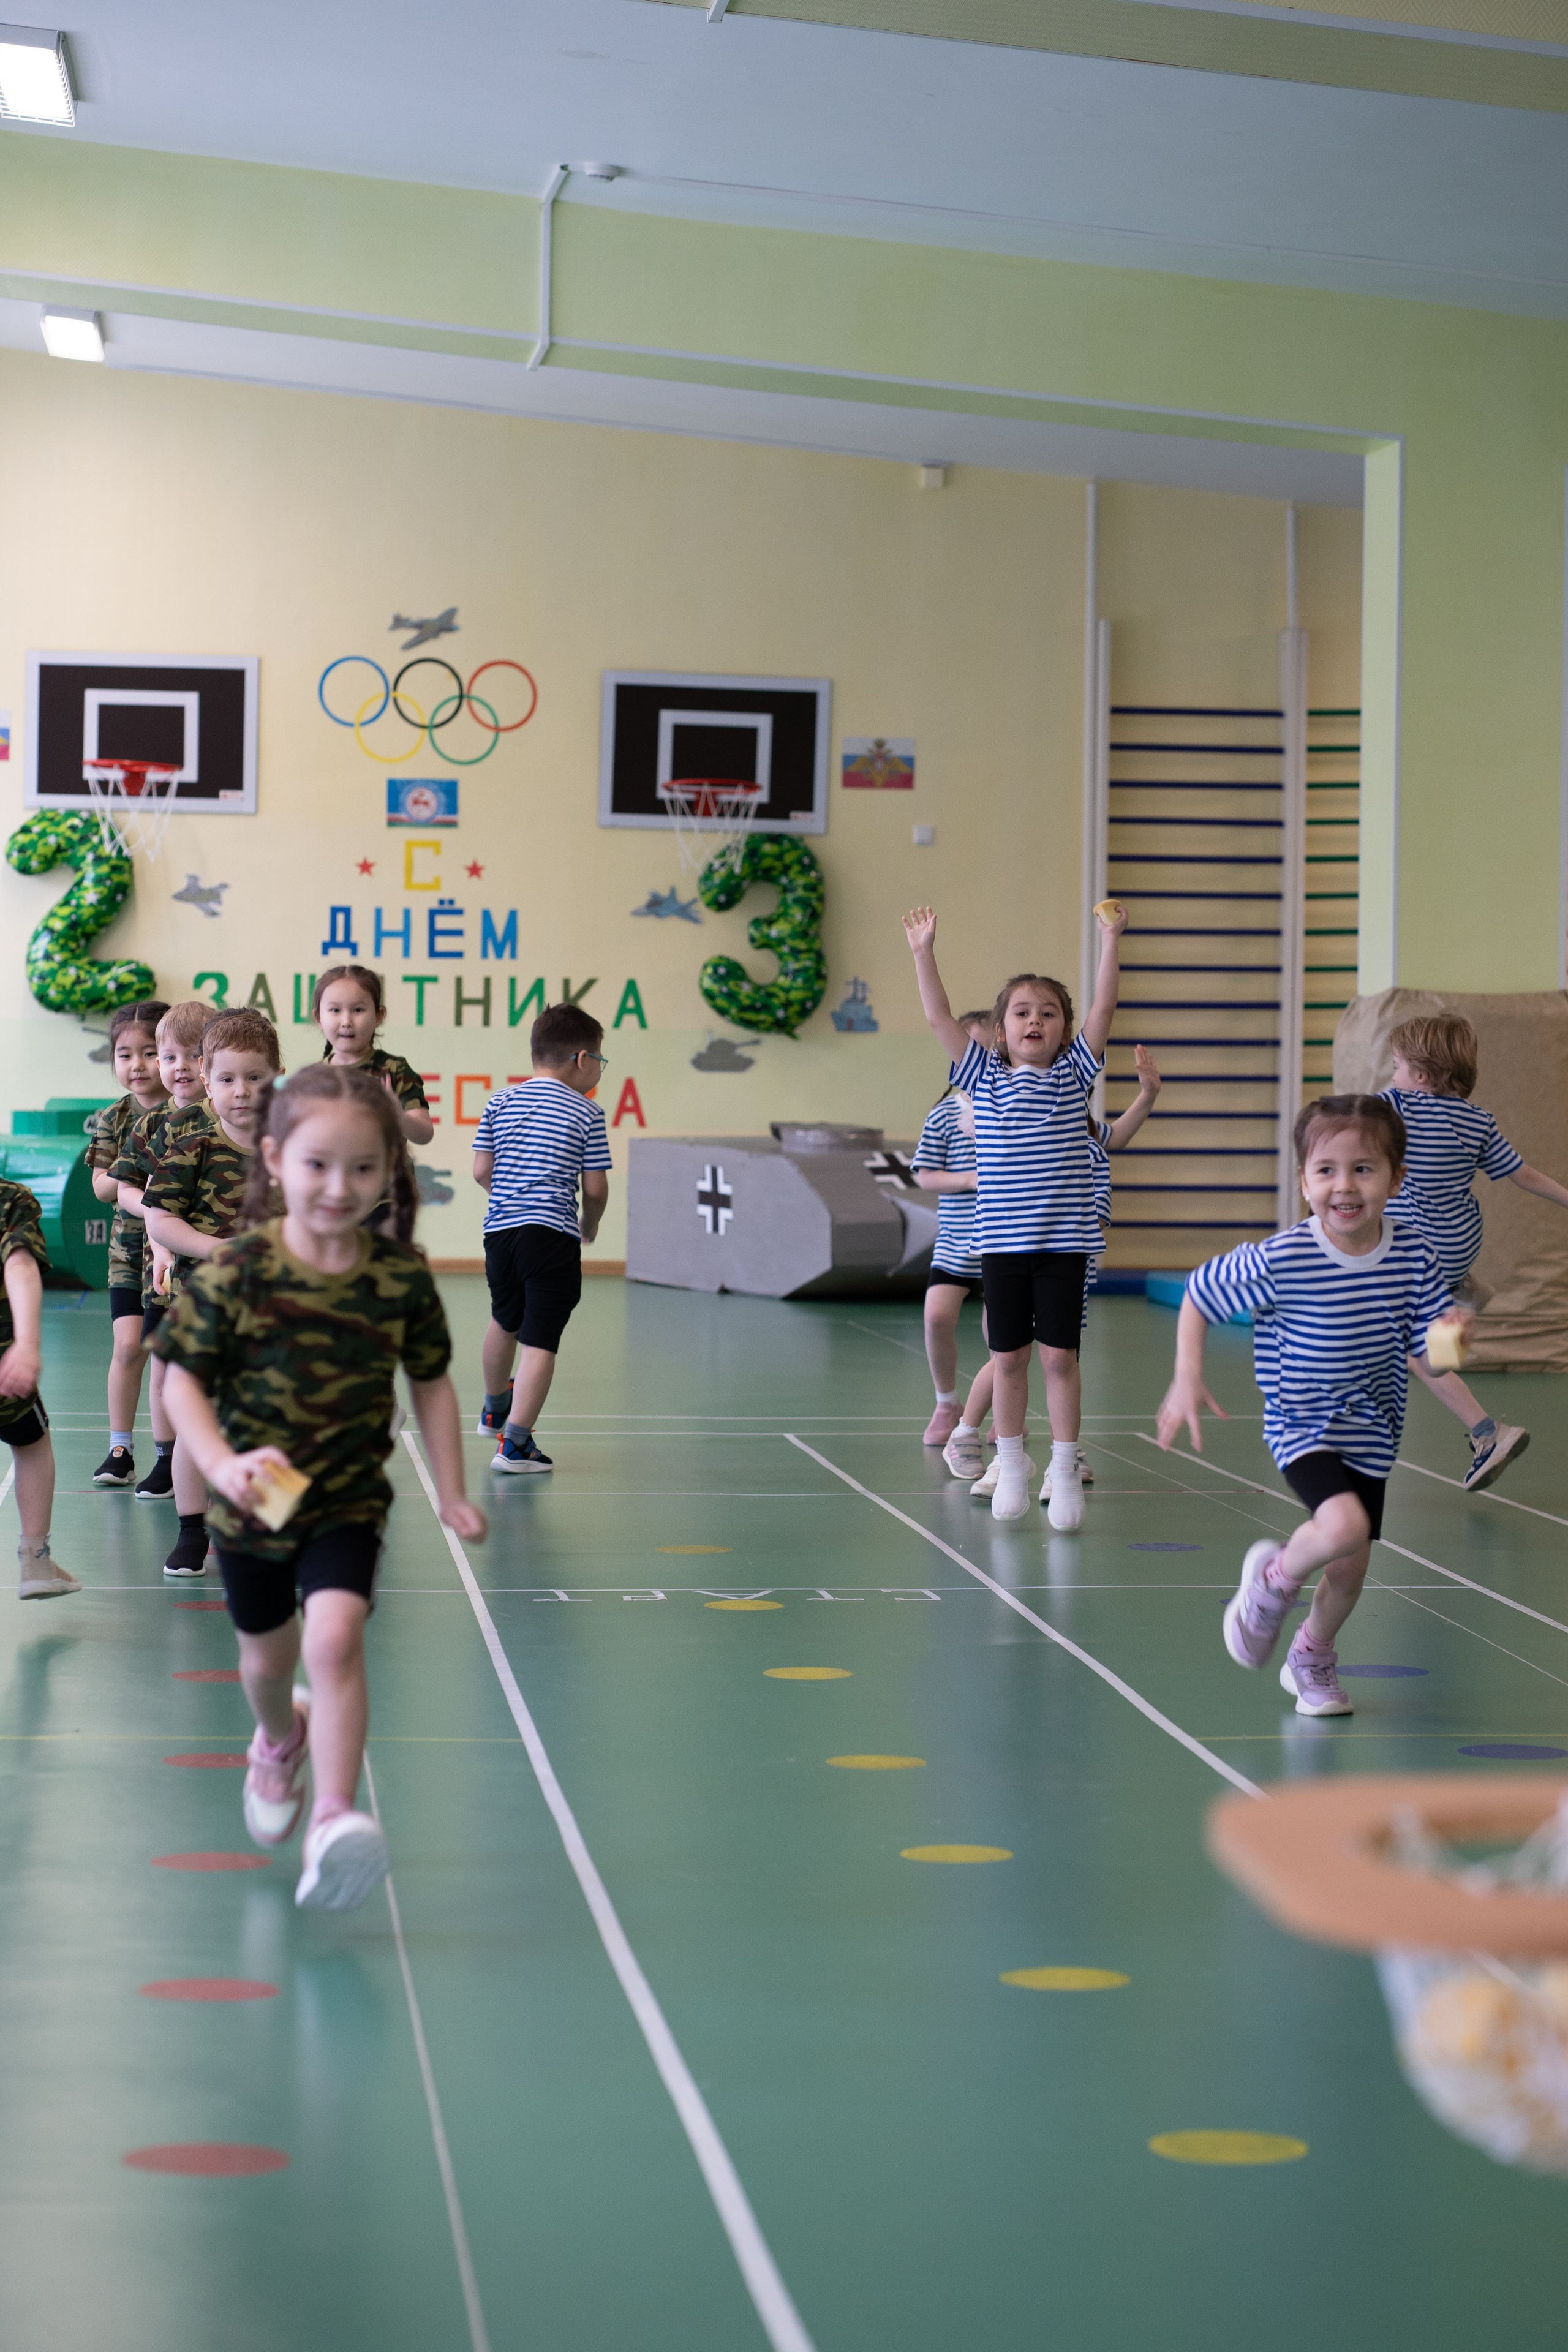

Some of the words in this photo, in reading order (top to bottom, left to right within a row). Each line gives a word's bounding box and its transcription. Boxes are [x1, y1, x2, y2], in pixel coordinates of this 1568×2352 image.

[405, 840, 442, 891] С
[5, 807, 156, 1012] 2
[321, 898, 518, 959] ДНЁМ
[698, 832, 827, 1035] 3
[192, 971, 648, 1029] ЗАТНИКА
[533, 1589, 942, 1601] СТАРТ
